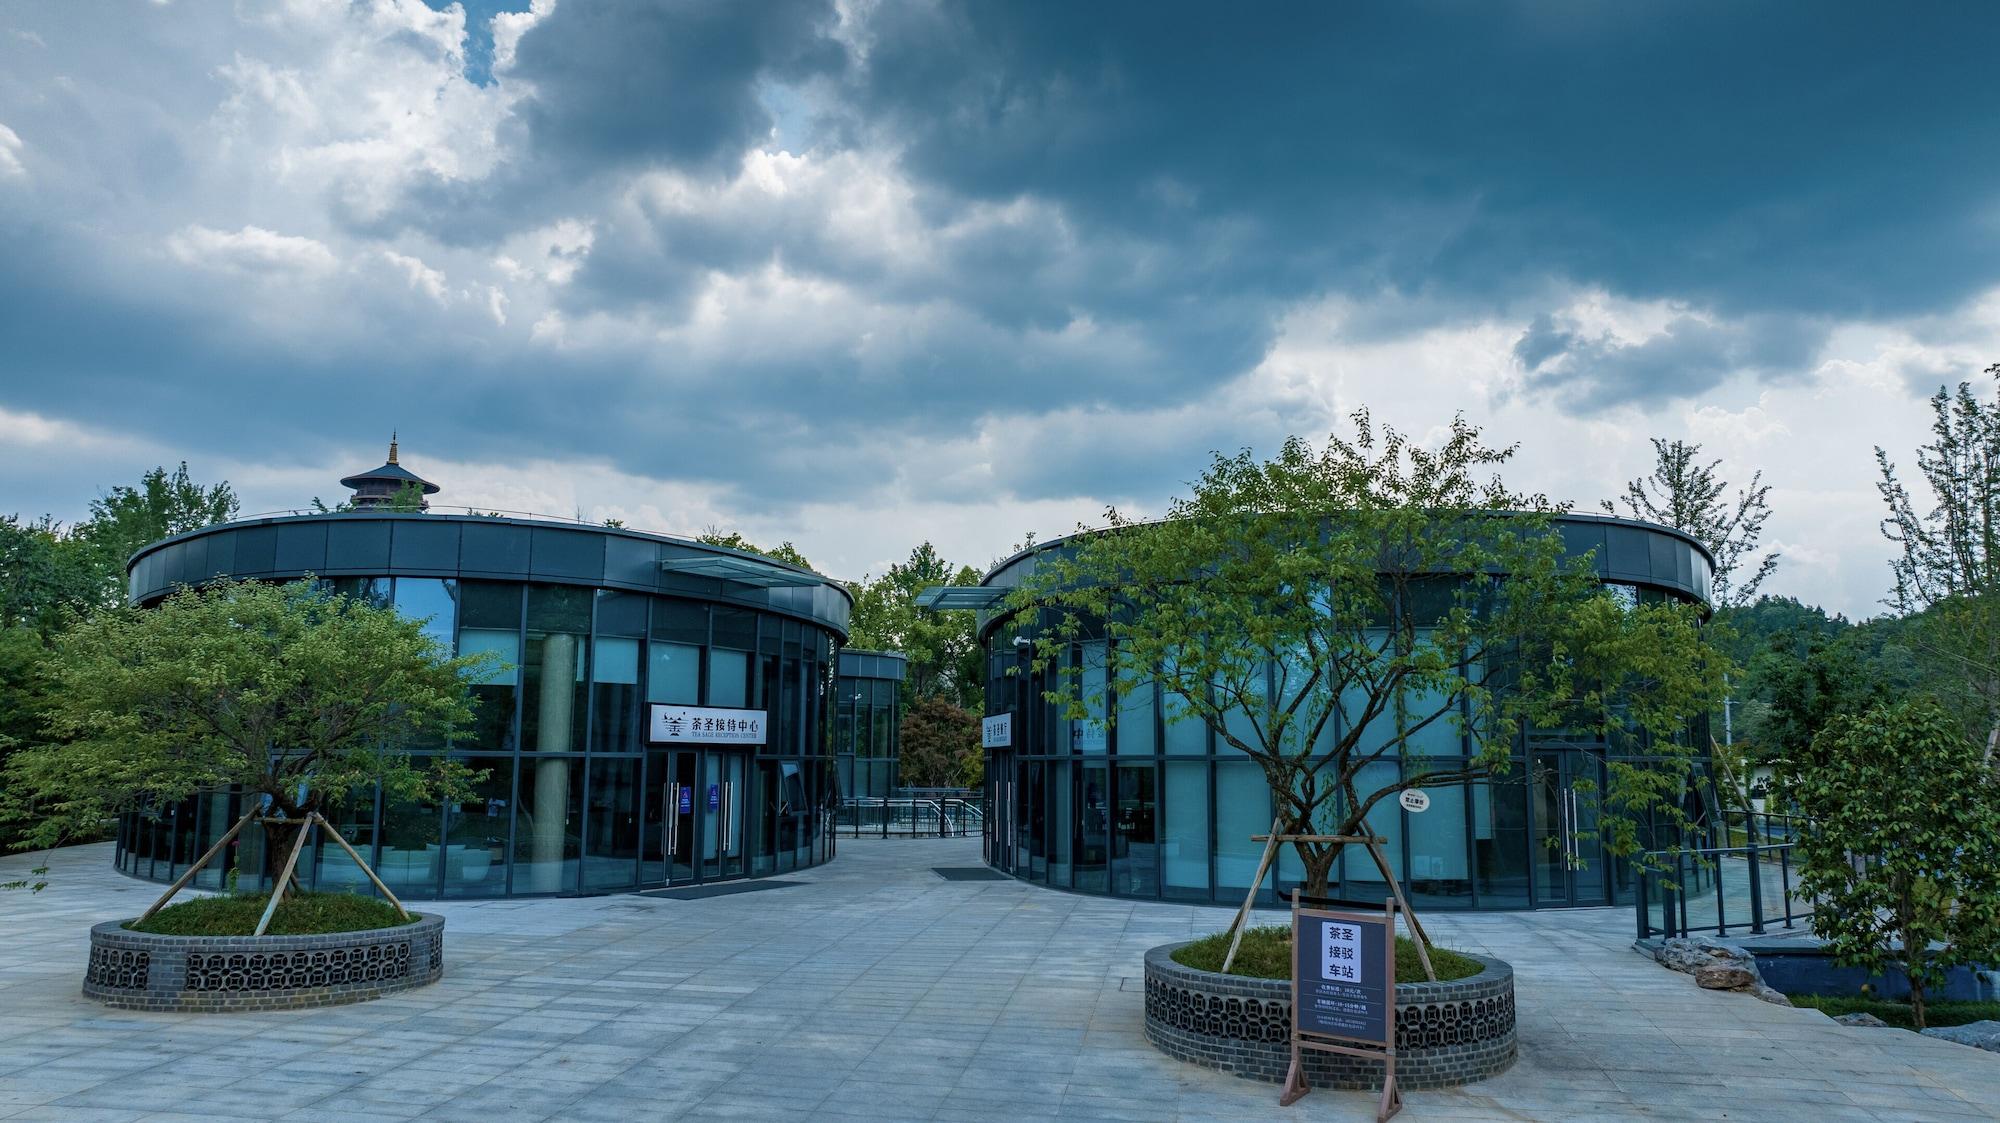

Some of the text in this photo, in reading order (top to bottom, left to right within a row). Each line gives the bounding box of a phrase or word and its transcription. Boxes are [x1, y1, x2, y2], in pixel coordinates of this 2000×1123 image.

[691, 717, 759, 733] 茶圣接待中心
[1329, 926, 1354, 941] 茶圣
[1329, 945, 1354, 960] 接驳
[1329, 963, 1354, 979] 车站
